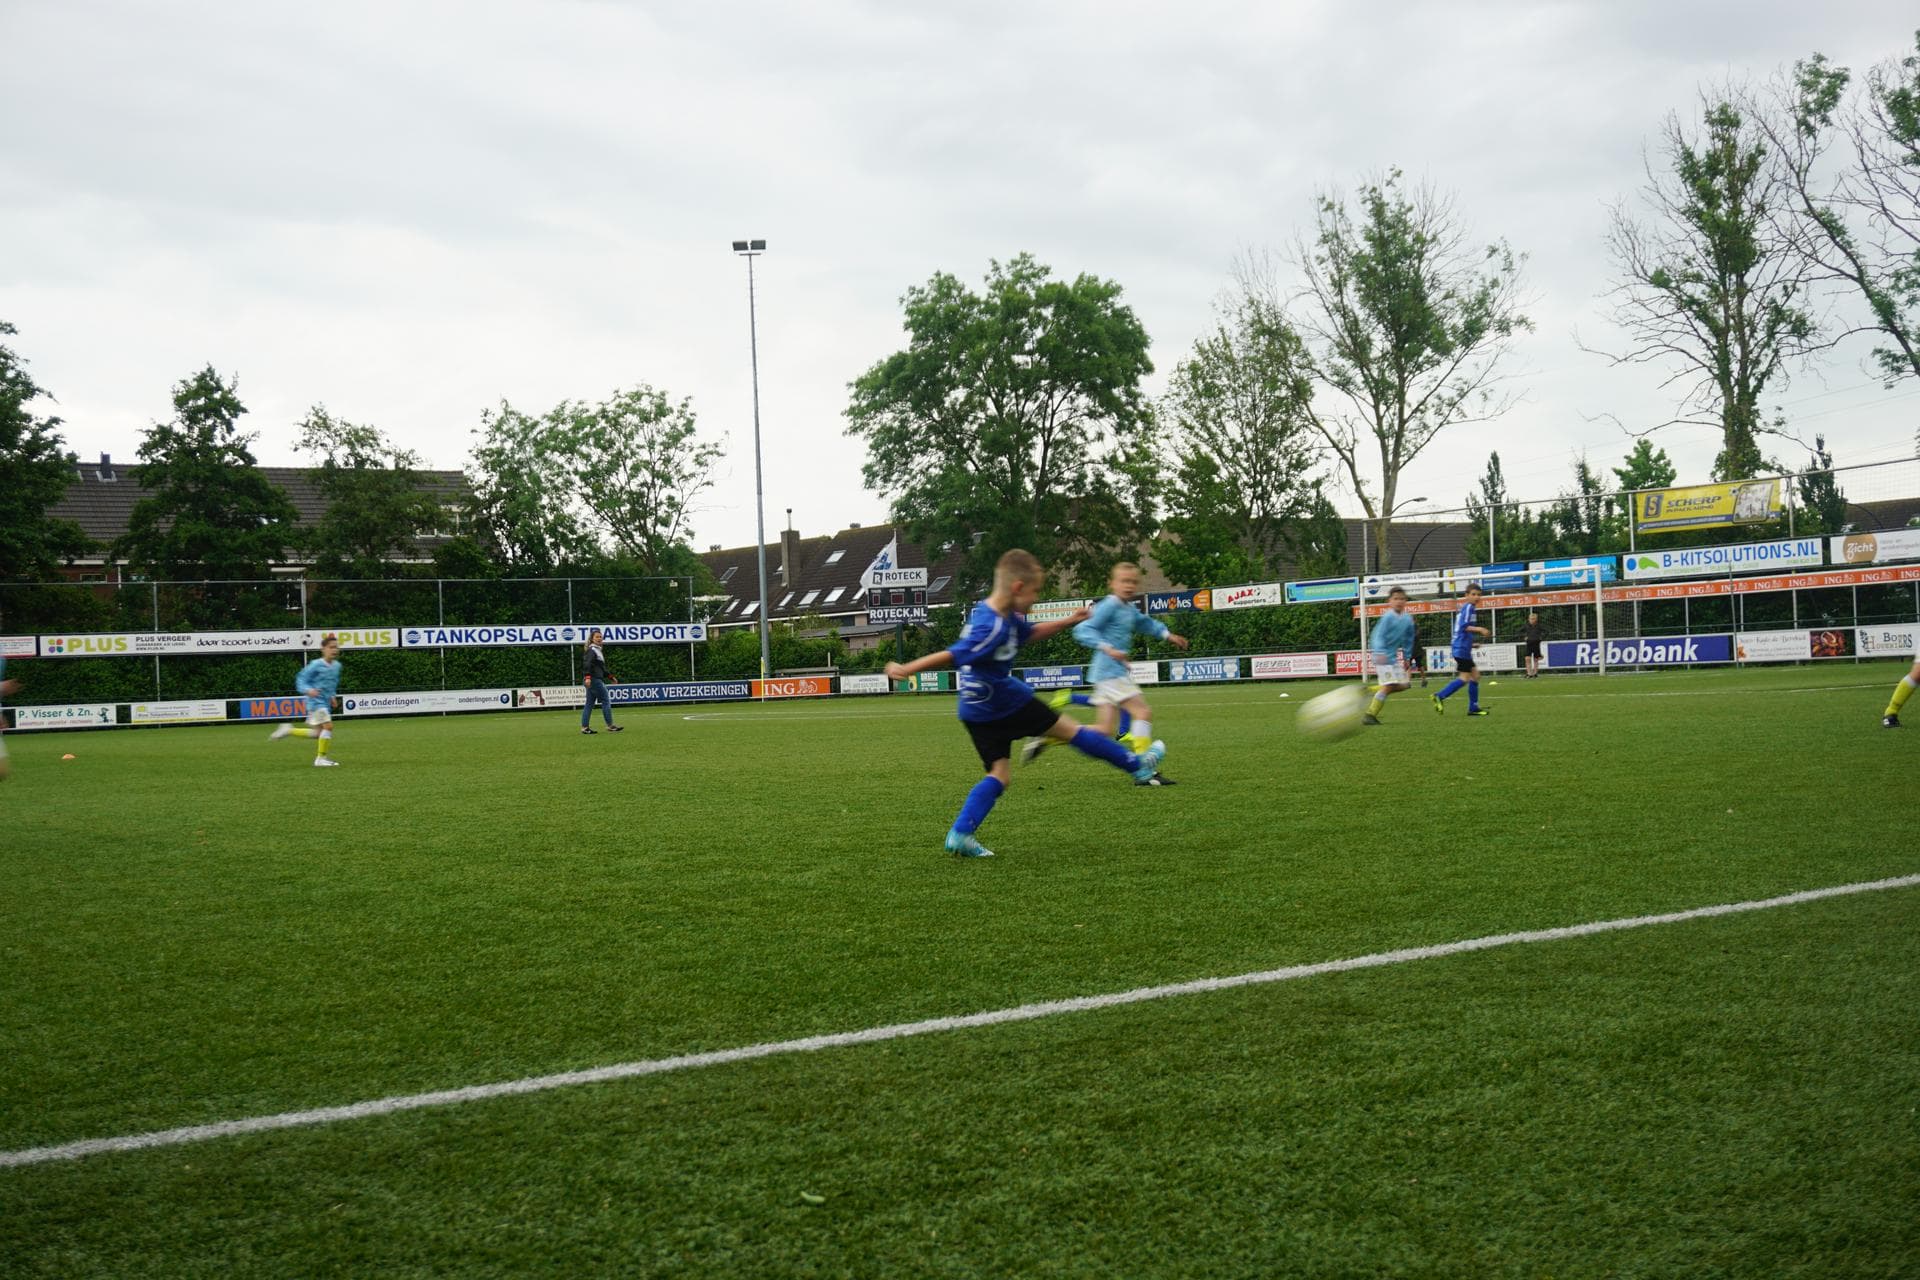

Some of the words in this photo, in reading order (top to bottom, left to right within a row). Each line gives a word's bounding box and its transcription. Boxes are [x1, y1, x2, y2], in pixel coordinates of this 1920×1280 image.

[1667, 496, 1722, 508] SCHERP
[1663, 541, 1819, 568] B-KITSOLUTIONS.NL
[1847, 542, 1874, 560] Zicht
[885, 571, 921, 581] ROTECK
[1824, 577, 1842, 586] ING
[1861, 575, 1880, 583] ING
[1900, 572, 1920, 580] ING
[1754, 583, 1770, 591] ING
[1789, 580, 1805, 589] ING
[1228, 588, 1254, 603] AJAX
[1625, 591, 1640, 599] ING
[1657, 589, 1672, 597] ING
[1688, 587, 1704, 595] ING
[1482, 599, 1496, 607] ING
[1566, 595, 1580, 603] ING
[870, 608, 927, 619] ROTECK.NL
[197, 638, 218, 647] daar
[221, 638, 252, 646] scoort
[261, 636, 290, 645] zeker!
[337, 631, 392, 646] PLUS
[424, 628, 557, 644] TANKOPSLAG
[67, 637, 128, 652] PLUS
[1576, 638, 1699, 665] Rabobank
[1186, 663, 1223, 676] XANTHI
[608, 689, 629, 700] OOS
[631, 687, 659, 699] ROOK
[662, 684, 748, 698] VERZEKERINGEN
[764, 684, 795, 695] ING
[359, 699, 369, 707] de
[371, 697, 420, 707] Onderlingen
[458, 695, 499, 704] onderlingen.nl
[18, 710, 28, 718] P.
[31, 709, 63, 717] Visser
[66, 708, 74, 716] &
[77, 707, 94, 715] Zn.
[250, 700, 307, 718] MAGN
